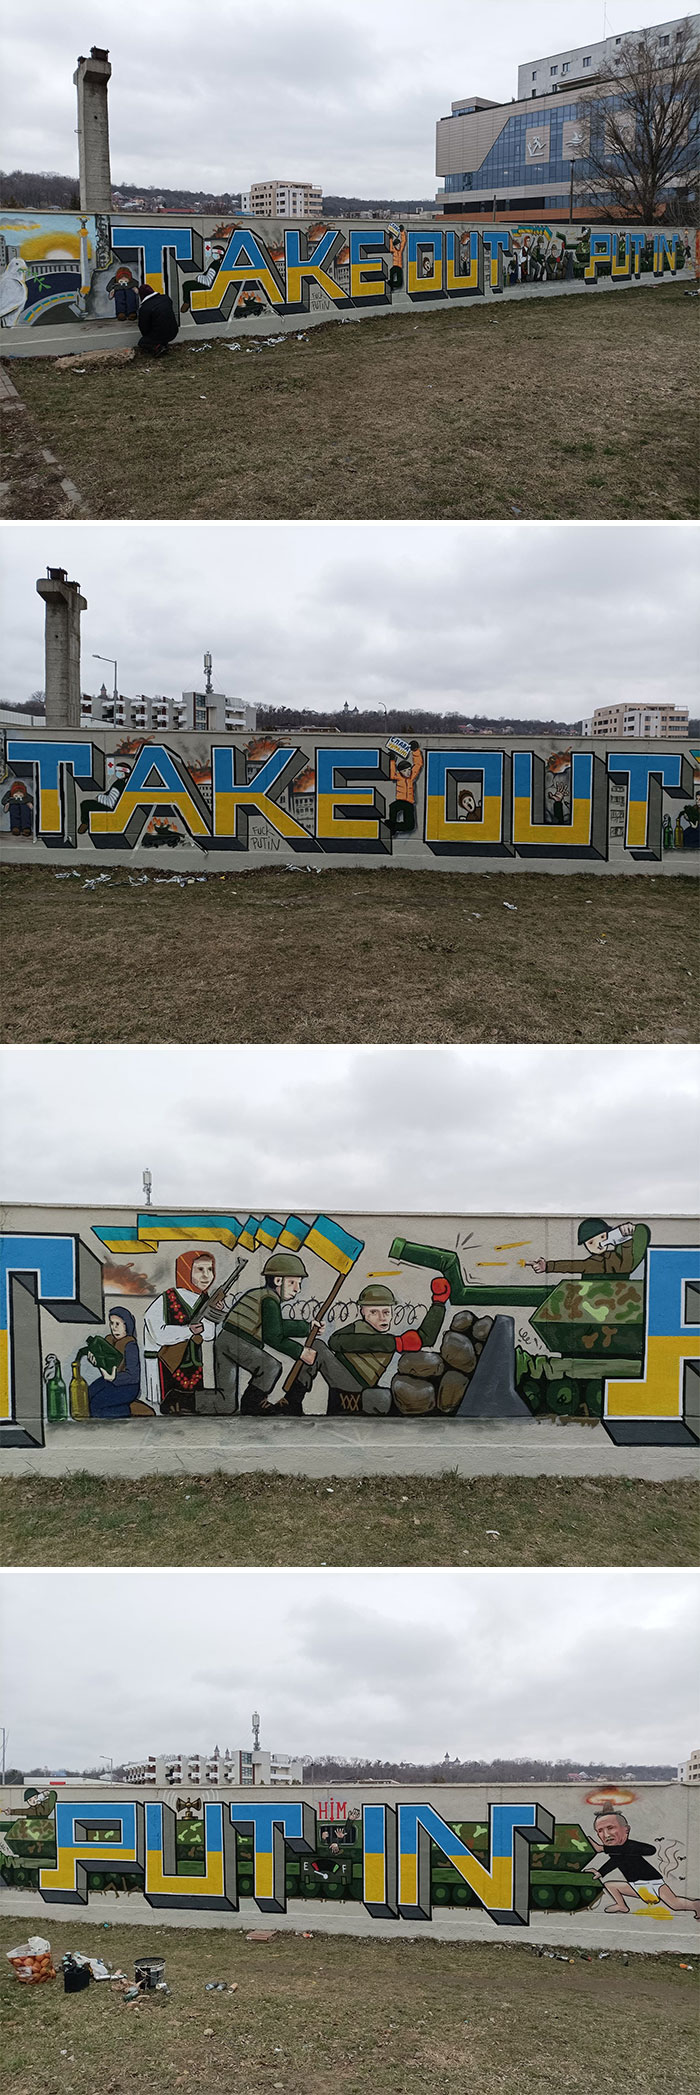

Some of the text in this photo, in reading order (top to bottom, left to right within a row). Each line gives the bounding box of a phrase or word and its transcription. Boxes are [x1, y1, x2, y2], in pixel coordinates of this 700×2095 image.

[110, 225, 388, 318] TAKE
[407, 230, 511, 298] OUT
[6, 740, 688, 855] TAKE OUT
[252, 824, 275, 836] FUCK
[40, 1801, 547, 1919] PUT IN
[303, 1861, 347, 1874] E F
